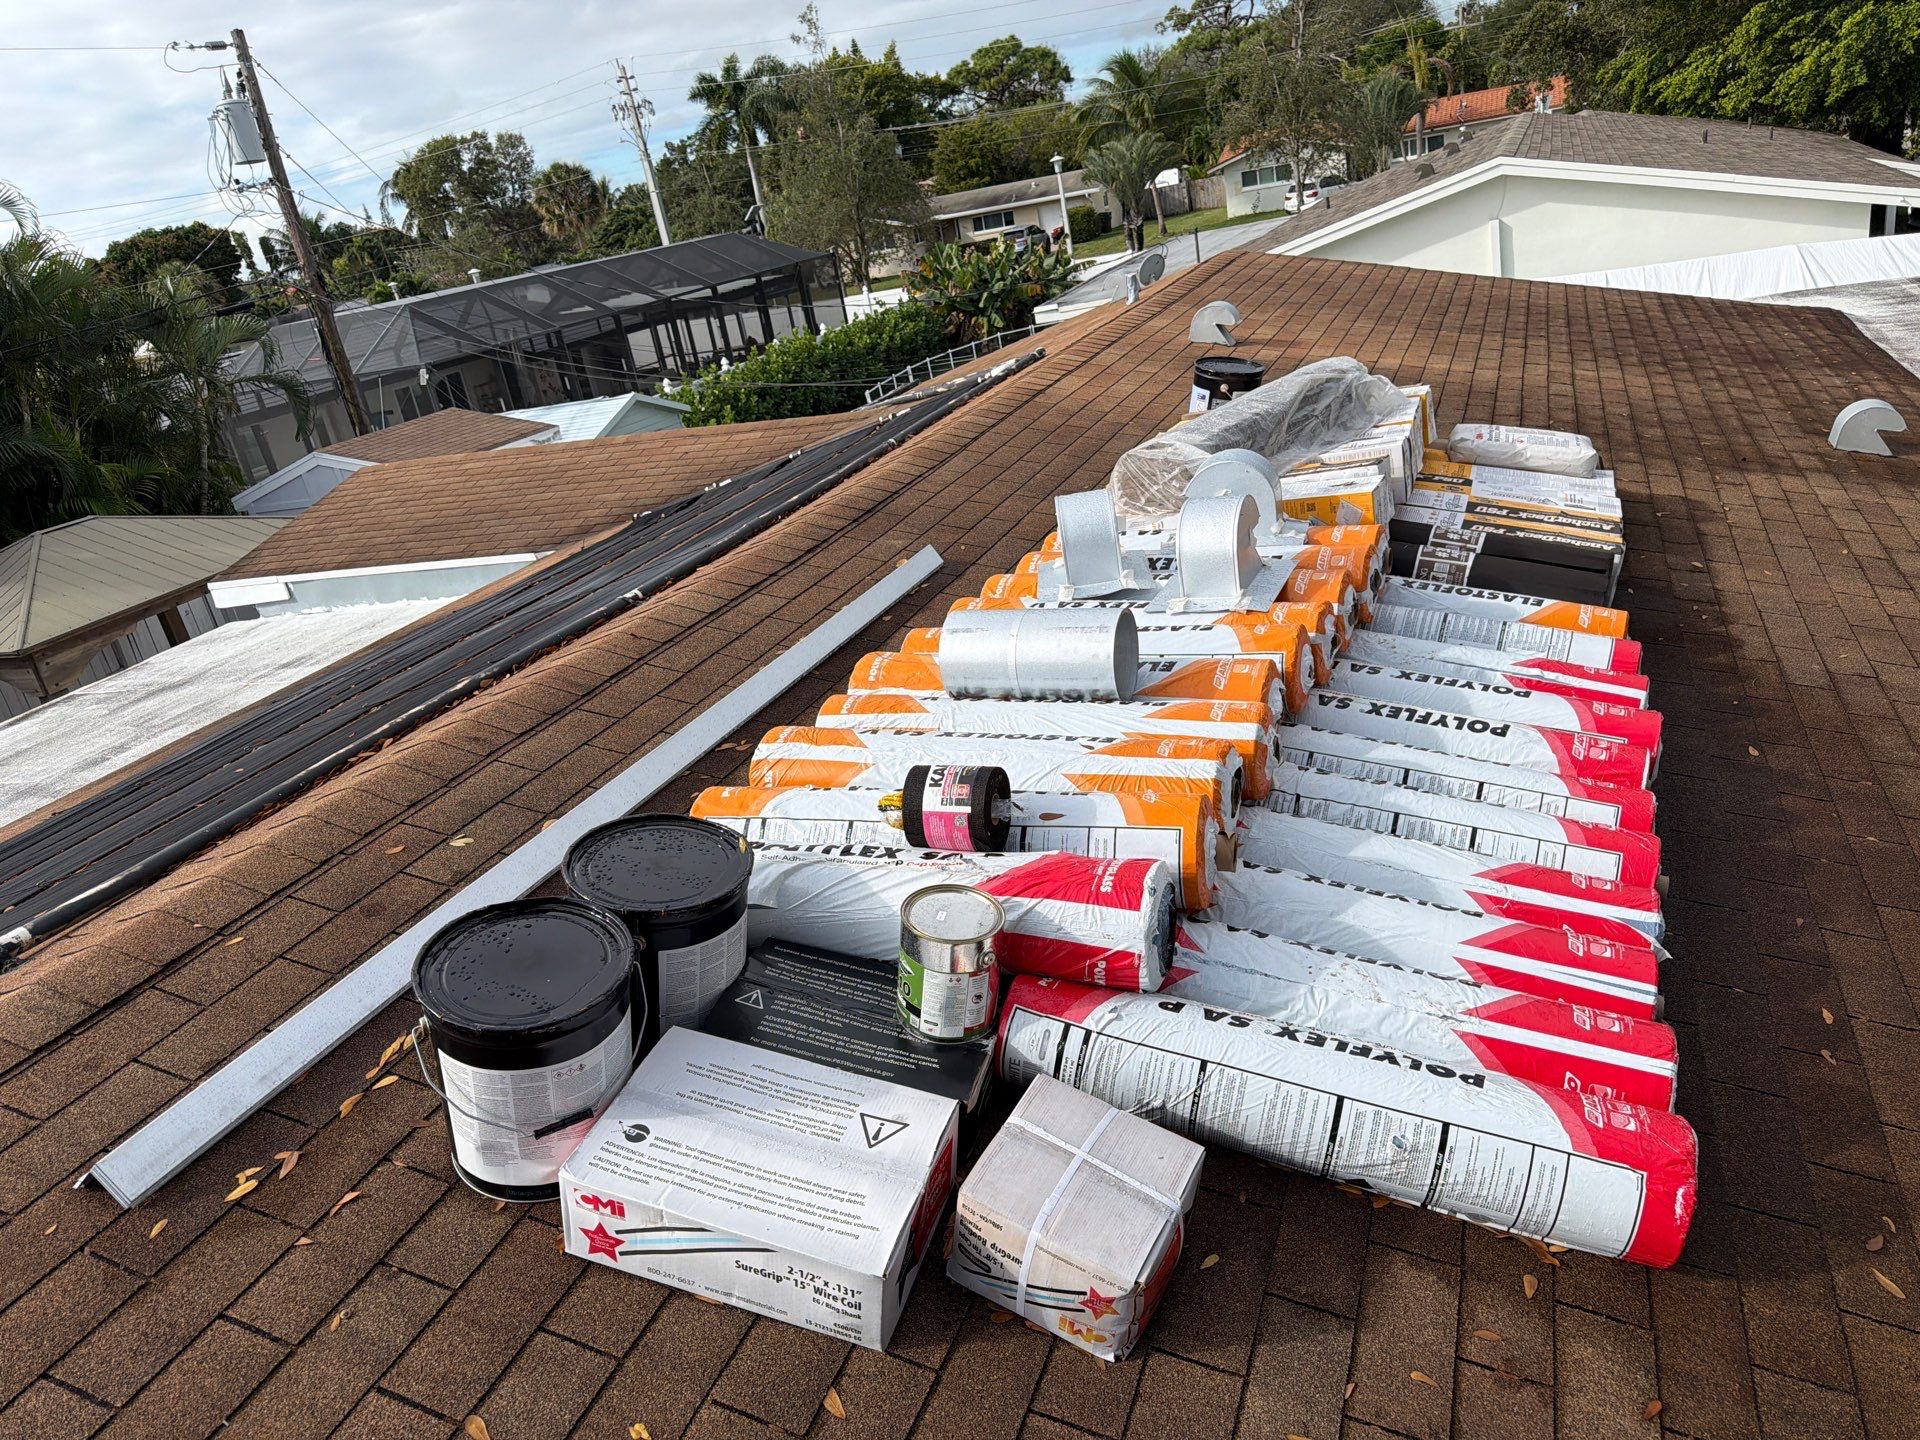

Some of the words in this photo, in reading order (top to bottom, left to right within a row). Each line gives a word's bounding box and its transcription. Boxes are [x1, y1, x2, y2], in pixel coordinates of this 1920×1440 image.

[1402, 578, 1544, 606] ELASTOFLEX
[1350, 662, 1381, 676] SA
[1319, 693, 1352, 708] SA
[1204, 1007, 1249, 1028] SA
[760, 1039, 777, 1047] more
[760, 1020, 797, 1033] reconocidos
[815, 1033, 836, 1044] estado
[845, 1042, 875, 1054] California
[874, 1048, 888, 1056] que
[887, 1053, 918, 1063] provocan
[918, 1060, 940, 1069] cancer,
[764, 1014, 806, 1029] ADVERTENCIA:
[808, 1026, 822, 1034] Este
[821, 1030, 850, 1041] producto
[850, 1038, 877, 1048] contiene
[876, 1045, 909, 1056] productos
[835, 1046, 852, 1054] otros
[852, 1050, 871, 1059] danos
[871, 1055, 916, 1069] reproductivos.
[603, 1140, 646, 1158] ADVERTENCIA:
[657, 1159, 690, 1171] operadores
[756, 1189, 784, 1200] personas
[784, 1196, 805, 1206] dentro
[838, 1210, 862, 1220] trabajo.
[617, 1172, 650, 1185] acceptable.
[648, 1142, 670, 1152] glasses
[676, 1150, 693, 1158] order
[698, 1157, 723, 1168] prevent
[722, 1164, 744, 1174] serious
[754, 1173, 772, 1183] injury
[772, 1178, 788, 1186] from
[787, 1182, 815, 1194] fasteners
[827, 1193, 845, 1203] flying
[845, 1197, 865, 1206] debris.
[653, 1135, 683, 1148] WARNING:
[684, 1144, 698, 1152] Tool
[696, 1149, 724, 1161] operators
[724, 1157, 737, 1165] and
[736, 1161, 755, 1170] others
[762, 1169, 778, 1177] work
[791, 1176, 813, 1186] should
[811, 1182, 832, 1191] always
[848, 1191, 867, 1200] safety
[621, 1154, 635, 1162] usar
[634, 1158, 658, 1169] siempre
[657, 1165, 676, 1175] lentes
[684, 1174, 714, 1186] seguridad
[712, 1183, 728, 1191] para
[727, 1187, 753, 1198] prevenir
[752, 1194, 777, 1205] lesiones
[777, 1202, 795, 1210] serias
[795, 1206, 818, 1217] debido
[853, 1222, 880, 1232] volantes.
[653, 1175, 670, 1184] these
[669, 1180, 697, 1192] fasteners
[705, 1192, 718, 1200] any
[717, 1196, 744, 1208] external
[742, 1203, 776, 1216] application
[776, 1213, 796, 1222] where
[796, 1219, 825, 1231] streaking
[834, 1229, 860, 1240] staining
[971, 1243, 982, 1257] Tin
[646, 1266, 695, 1286] 800-247-6637
[792, 1278, 811, 1290] 15°
[812, 1284, 839, 1303] Wire
[840, 1296, 862, 1311] Coil
[824, 1301, 840, 1314] Ring
[840, 1308, 862, 1320] Shank
